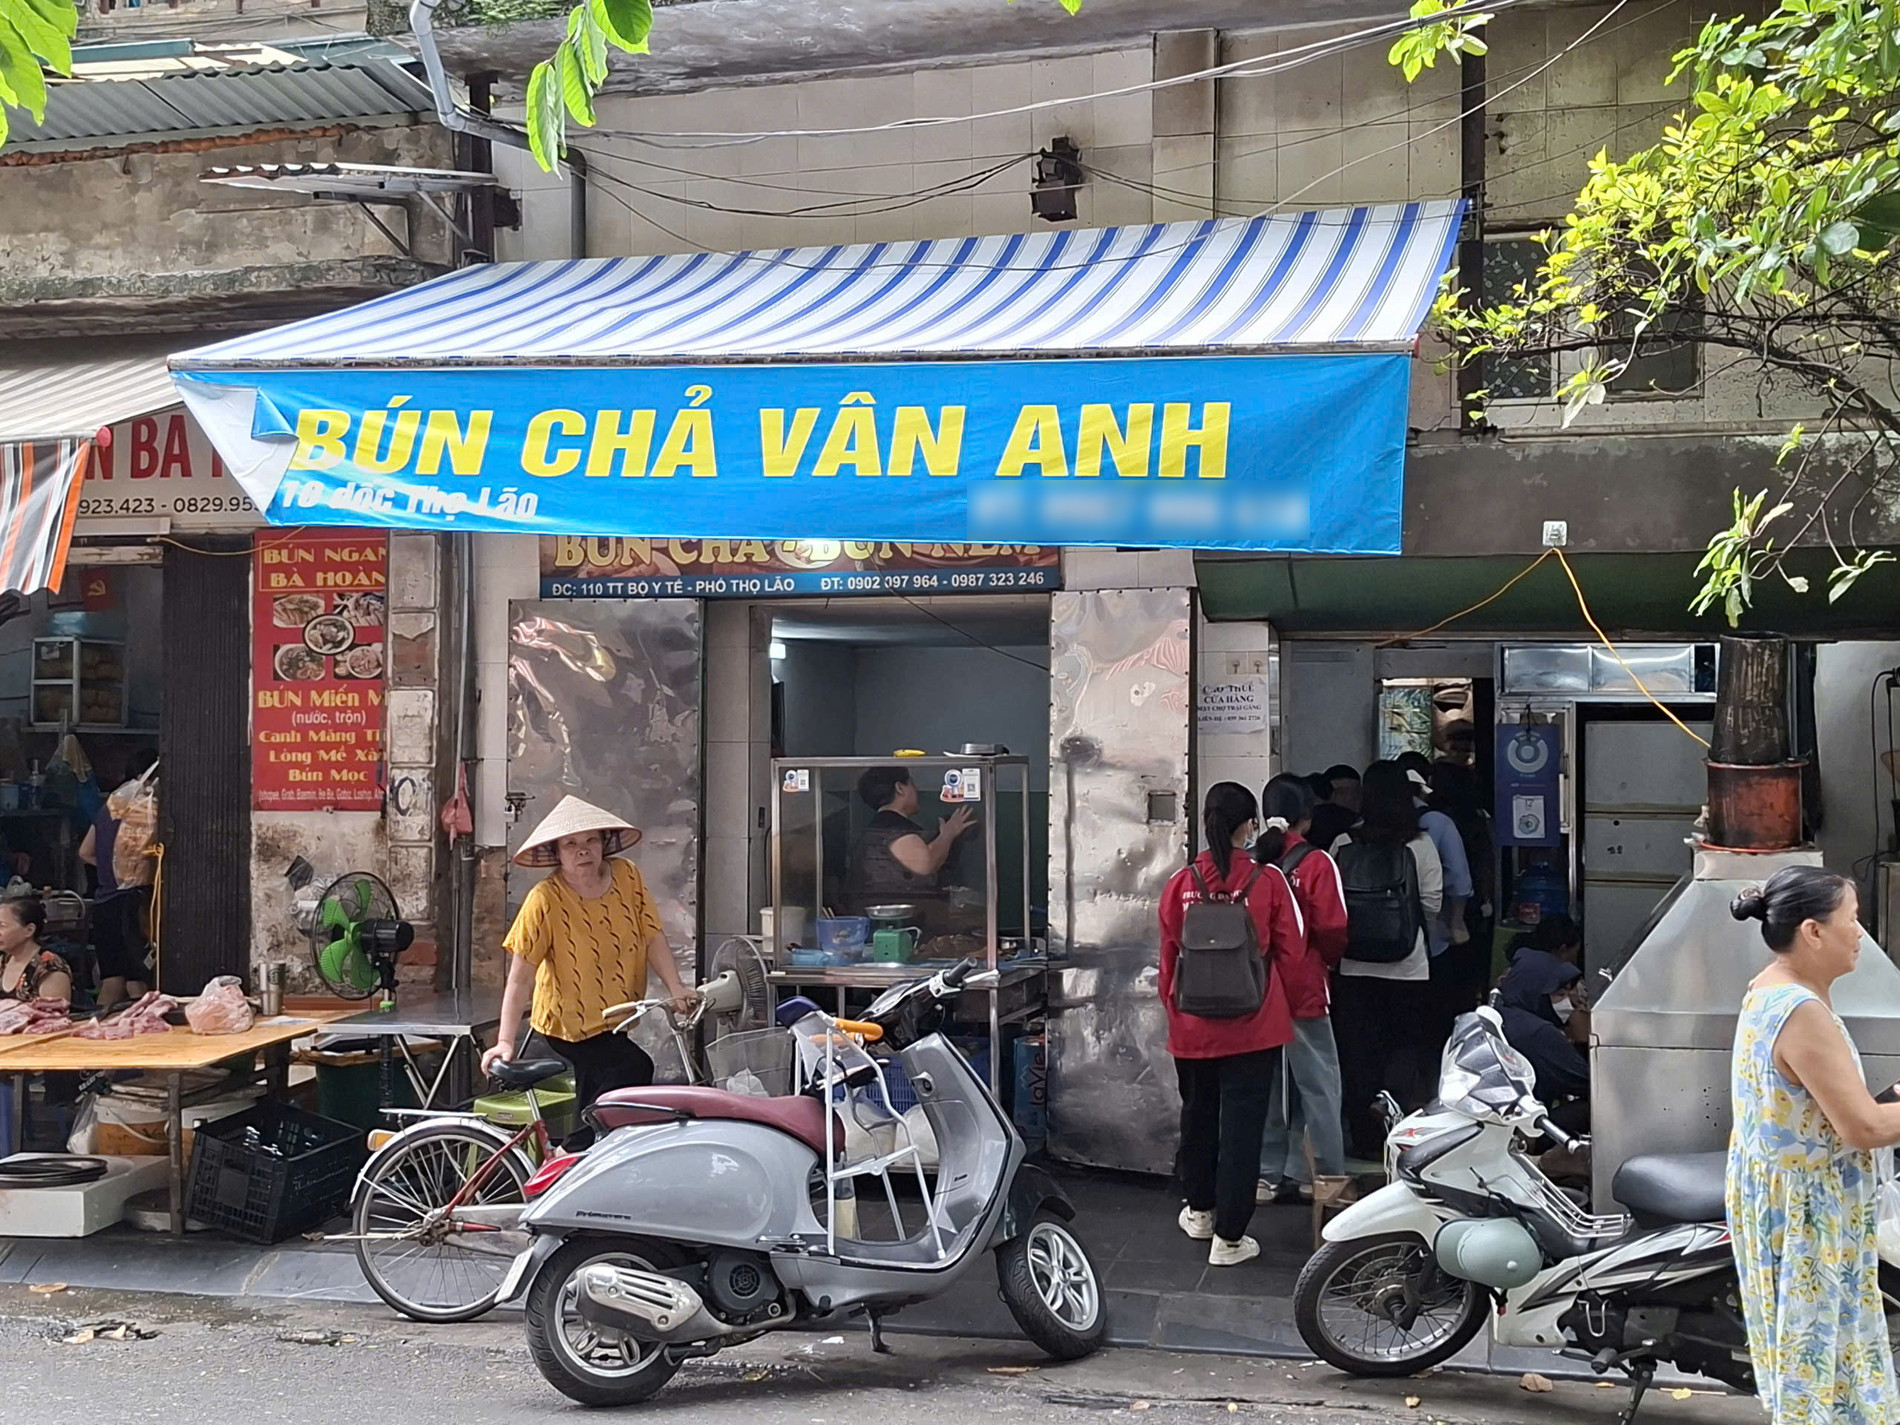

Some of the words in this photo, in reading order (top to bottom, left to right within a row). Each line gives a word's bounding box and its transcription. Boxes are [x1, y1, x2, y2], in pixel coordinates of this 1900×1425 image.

[289, 395, 494, 476] BÚN
[520, 385, 718, 478] CHẢ
[759, 391, 966, 477] VÂN
[995, 402, 1231, 478] ANH
[263, 544, 315, 564] BÚN
[270, 567, 305, 587] BÀ
[552, 583, 577, 596] ĐC:
[581, 583, 603, 595] 110
[607, 582, 624, 594] TT
[628, 580, 649, 597] BỘ
[652, 582, 663, 594] Y
[665, 578, 684, 594] TẾ
[695, 577, 727, 593] PHỐ
[730, 579, 761, 595] THỌ
[764, 576, 795, 592] LÃO
[821, 577, 843, 590] ĐT:
[848, 576, 881, 589] 0902
[913, 574, 938, 587] 964
[951, 573, 986, 587] 0987
[989, 573, 1014, 586] 323
[1018, 572, 1044, 585] 246
[258, 685, 302, 708] BÚN
[310, 684, 360, 707] Miến
[291, 710, 332, 726] (nước,
[335, 710, 367, 726] trộn)
[259, 730, 301, 743] Canh
[309, 729, 356, 744] Măng
[269, 749, 312, 765] Lòng
[318, 746, 347, 762] Mề
[288, 768, 323, 782] Bún
[330, 769, 369, 784] Mọc
